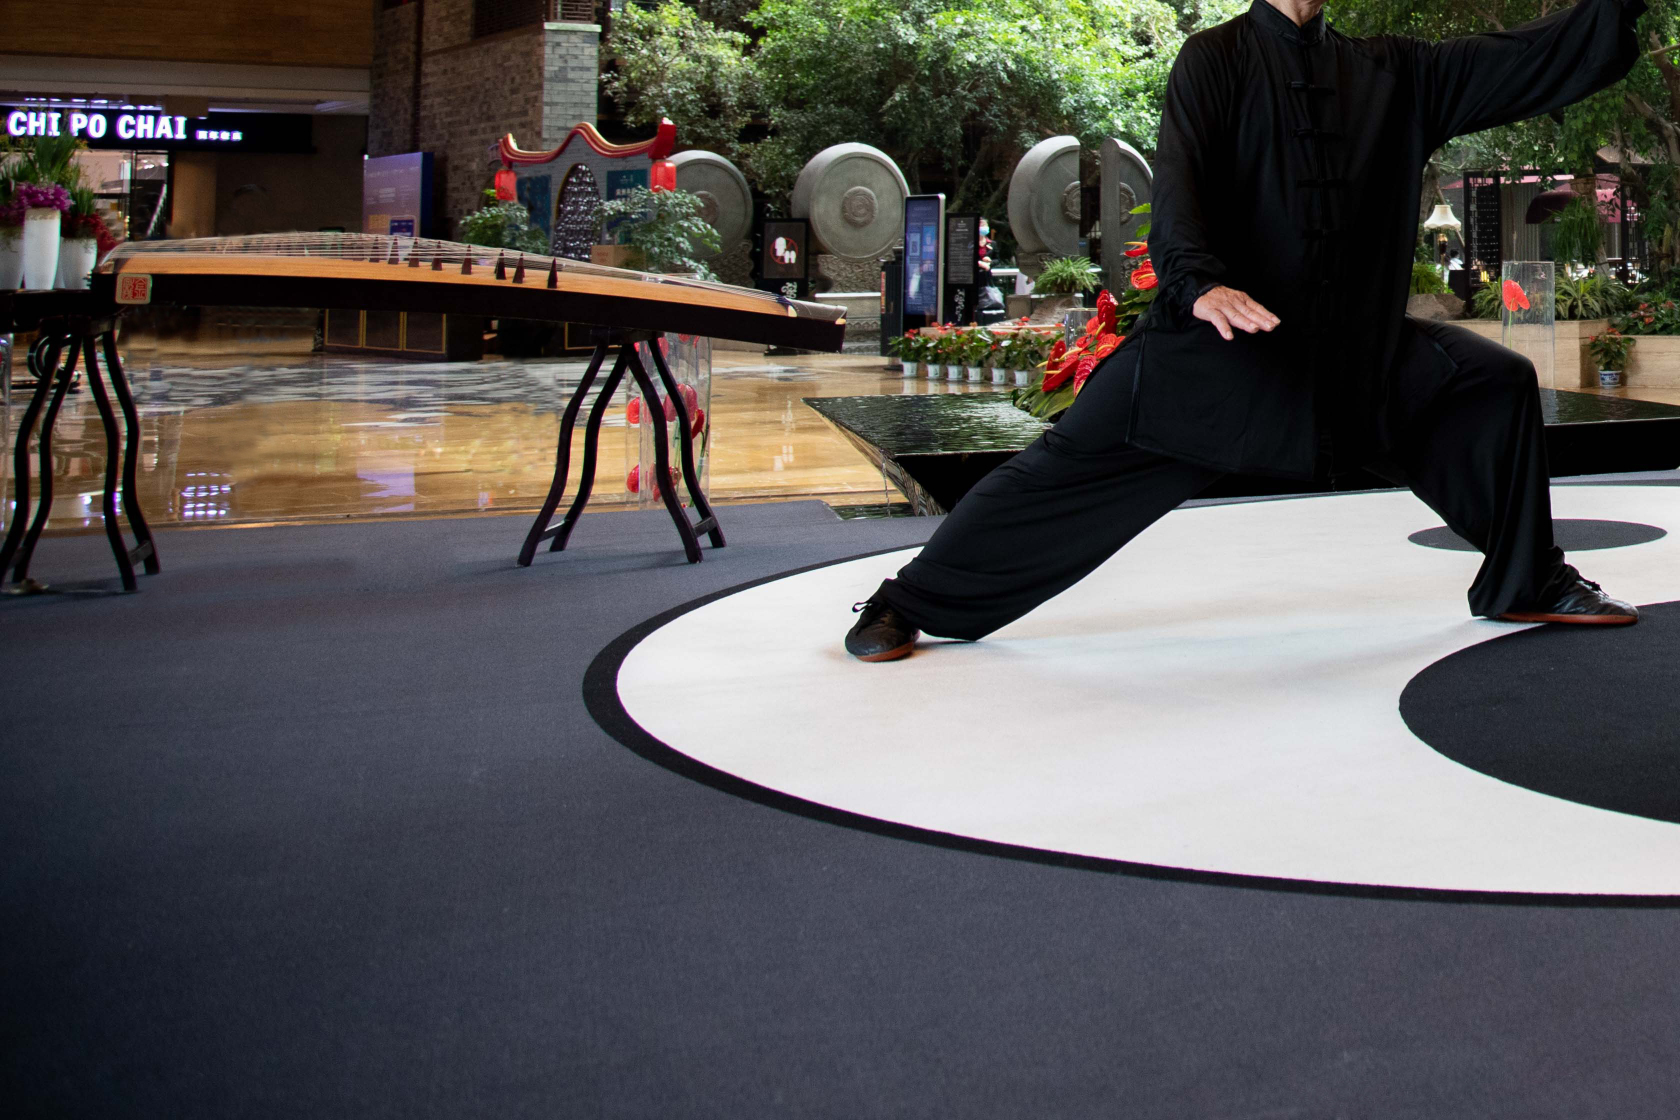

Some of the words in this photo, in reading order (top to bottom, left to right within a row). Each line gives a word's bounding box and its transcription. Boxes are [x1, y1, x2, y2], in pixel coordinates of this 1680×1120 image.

[8, 111, 61, 137] CHI
[70, 113, 107, 139] PO
[117, 115, 187, 140] CHAI
